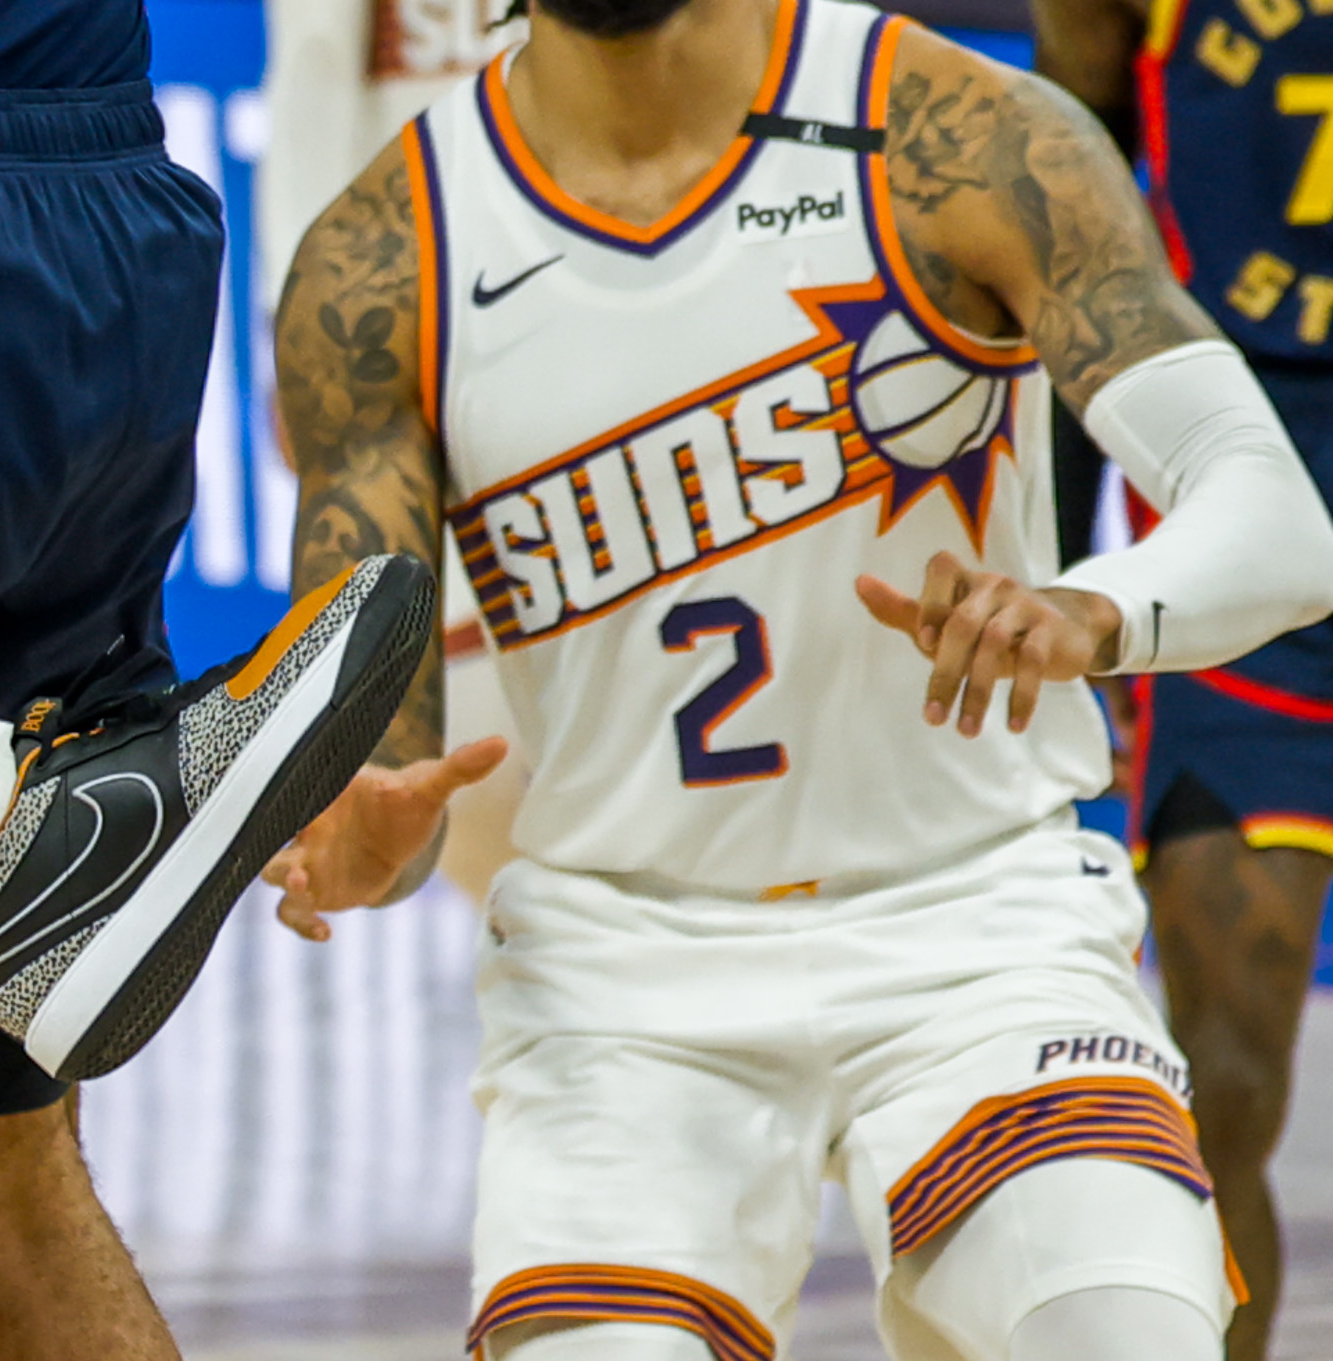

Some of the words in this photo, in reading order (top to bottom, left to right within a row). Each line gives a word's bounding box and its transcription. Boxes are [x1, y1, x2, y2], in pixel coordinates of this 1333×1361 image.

[737, 190, 844, 236] PayPal
[1274, 73, 1333, 226] 7
[482, 362, 847, 636] SUNS
[659, 596, 789, 788] 2
